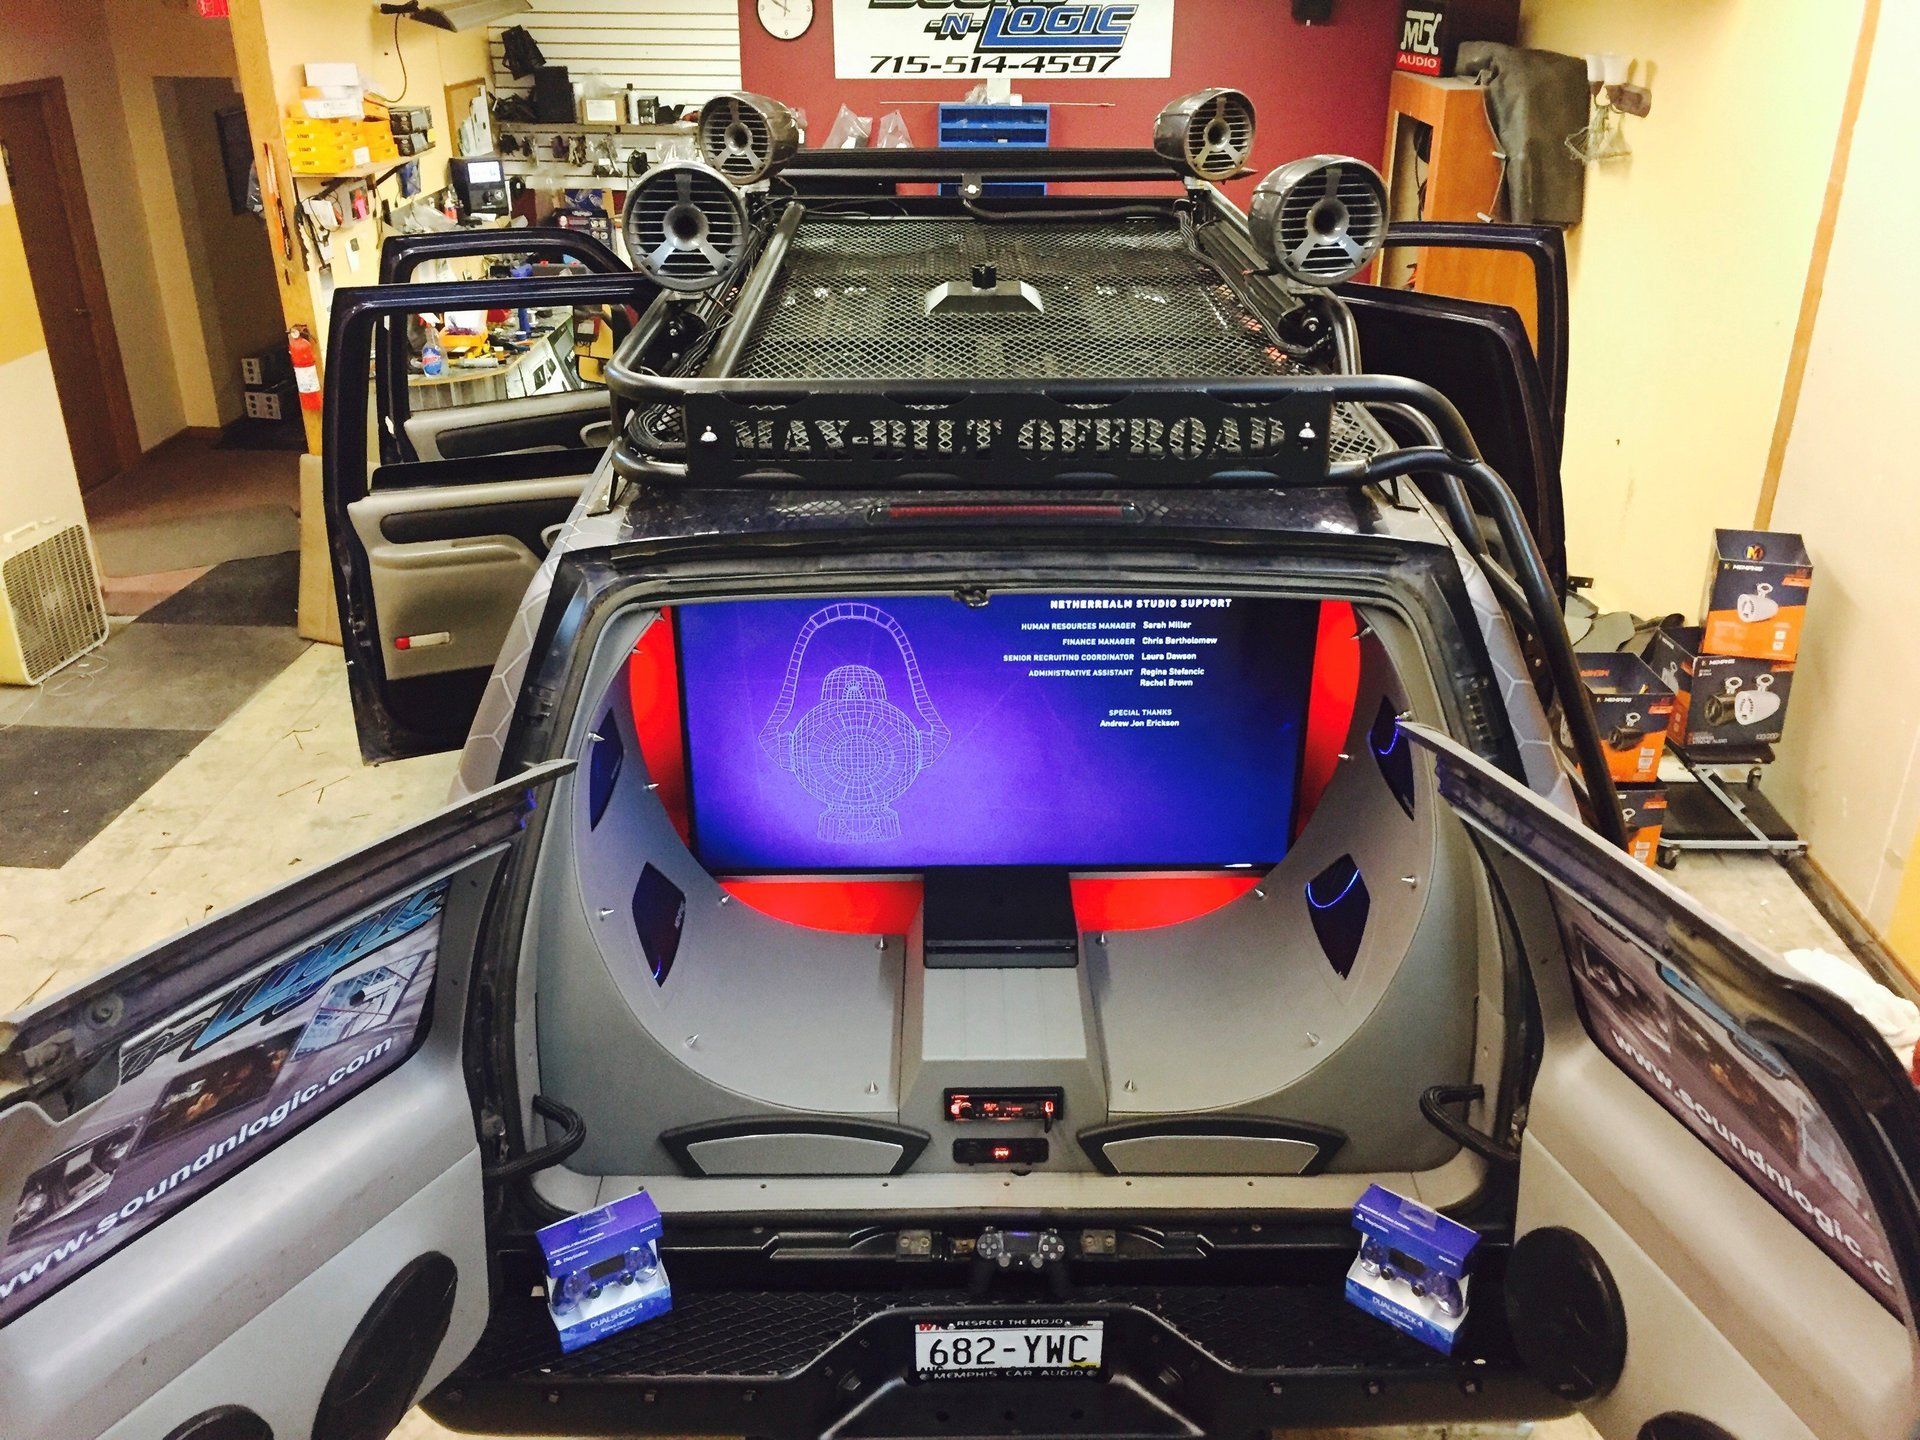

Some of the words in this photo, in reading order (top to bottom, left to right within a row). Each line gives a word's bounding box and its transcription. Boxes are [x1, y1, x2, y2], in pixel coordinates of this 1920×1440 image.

[974, 4, 1138, 53] LOGIC
[869, 55, 1121, 74] 715-514-4597
[1399, 54, 1437, 68] AUDIO
[1017, 416, 1287, 462] OFFROAD
[1050, 600, 1132, 609] NETHERREALM
[1136, 599, 1177, 608] STUDIO
[1180, 598, 1232, 608] SUPPORT
[1052, 622, 1097, 630] RESOURCES
[1098, 622, 1136, 630] MANAGER
[1142, 621, 1166, 629] Sarah
[1168, 621, 1192, 629] Miller
[1062, 638, 1096, 646] FINANCE
[1142, 637, 1164, 645] Chris
[1165, 636, 1218, 644] Bartholomew
[1003, 654, 1032, 662] SENIOR
[1034, 654, 1080, 662] RECRUITING
[1142, 652, 1164, 660] Laura
[1166, 652, 1196, 660] Dawson
[1140, 668, 1167, 677] Regina
[1611, 1029, 1893, 1286] www.soundnlogic.c
[1008, 1318, 1028, 1326] THE
[1030, 1318, 1064, 1326] MOJO
[929, 1334, 1089, 1366] 682-YWC
[934, 1370, 998, 1380] MEMPHIS
[1006, 1370, 1033, 1378] CAR
[1041, 1369, 1083, 1377] AUDIO
